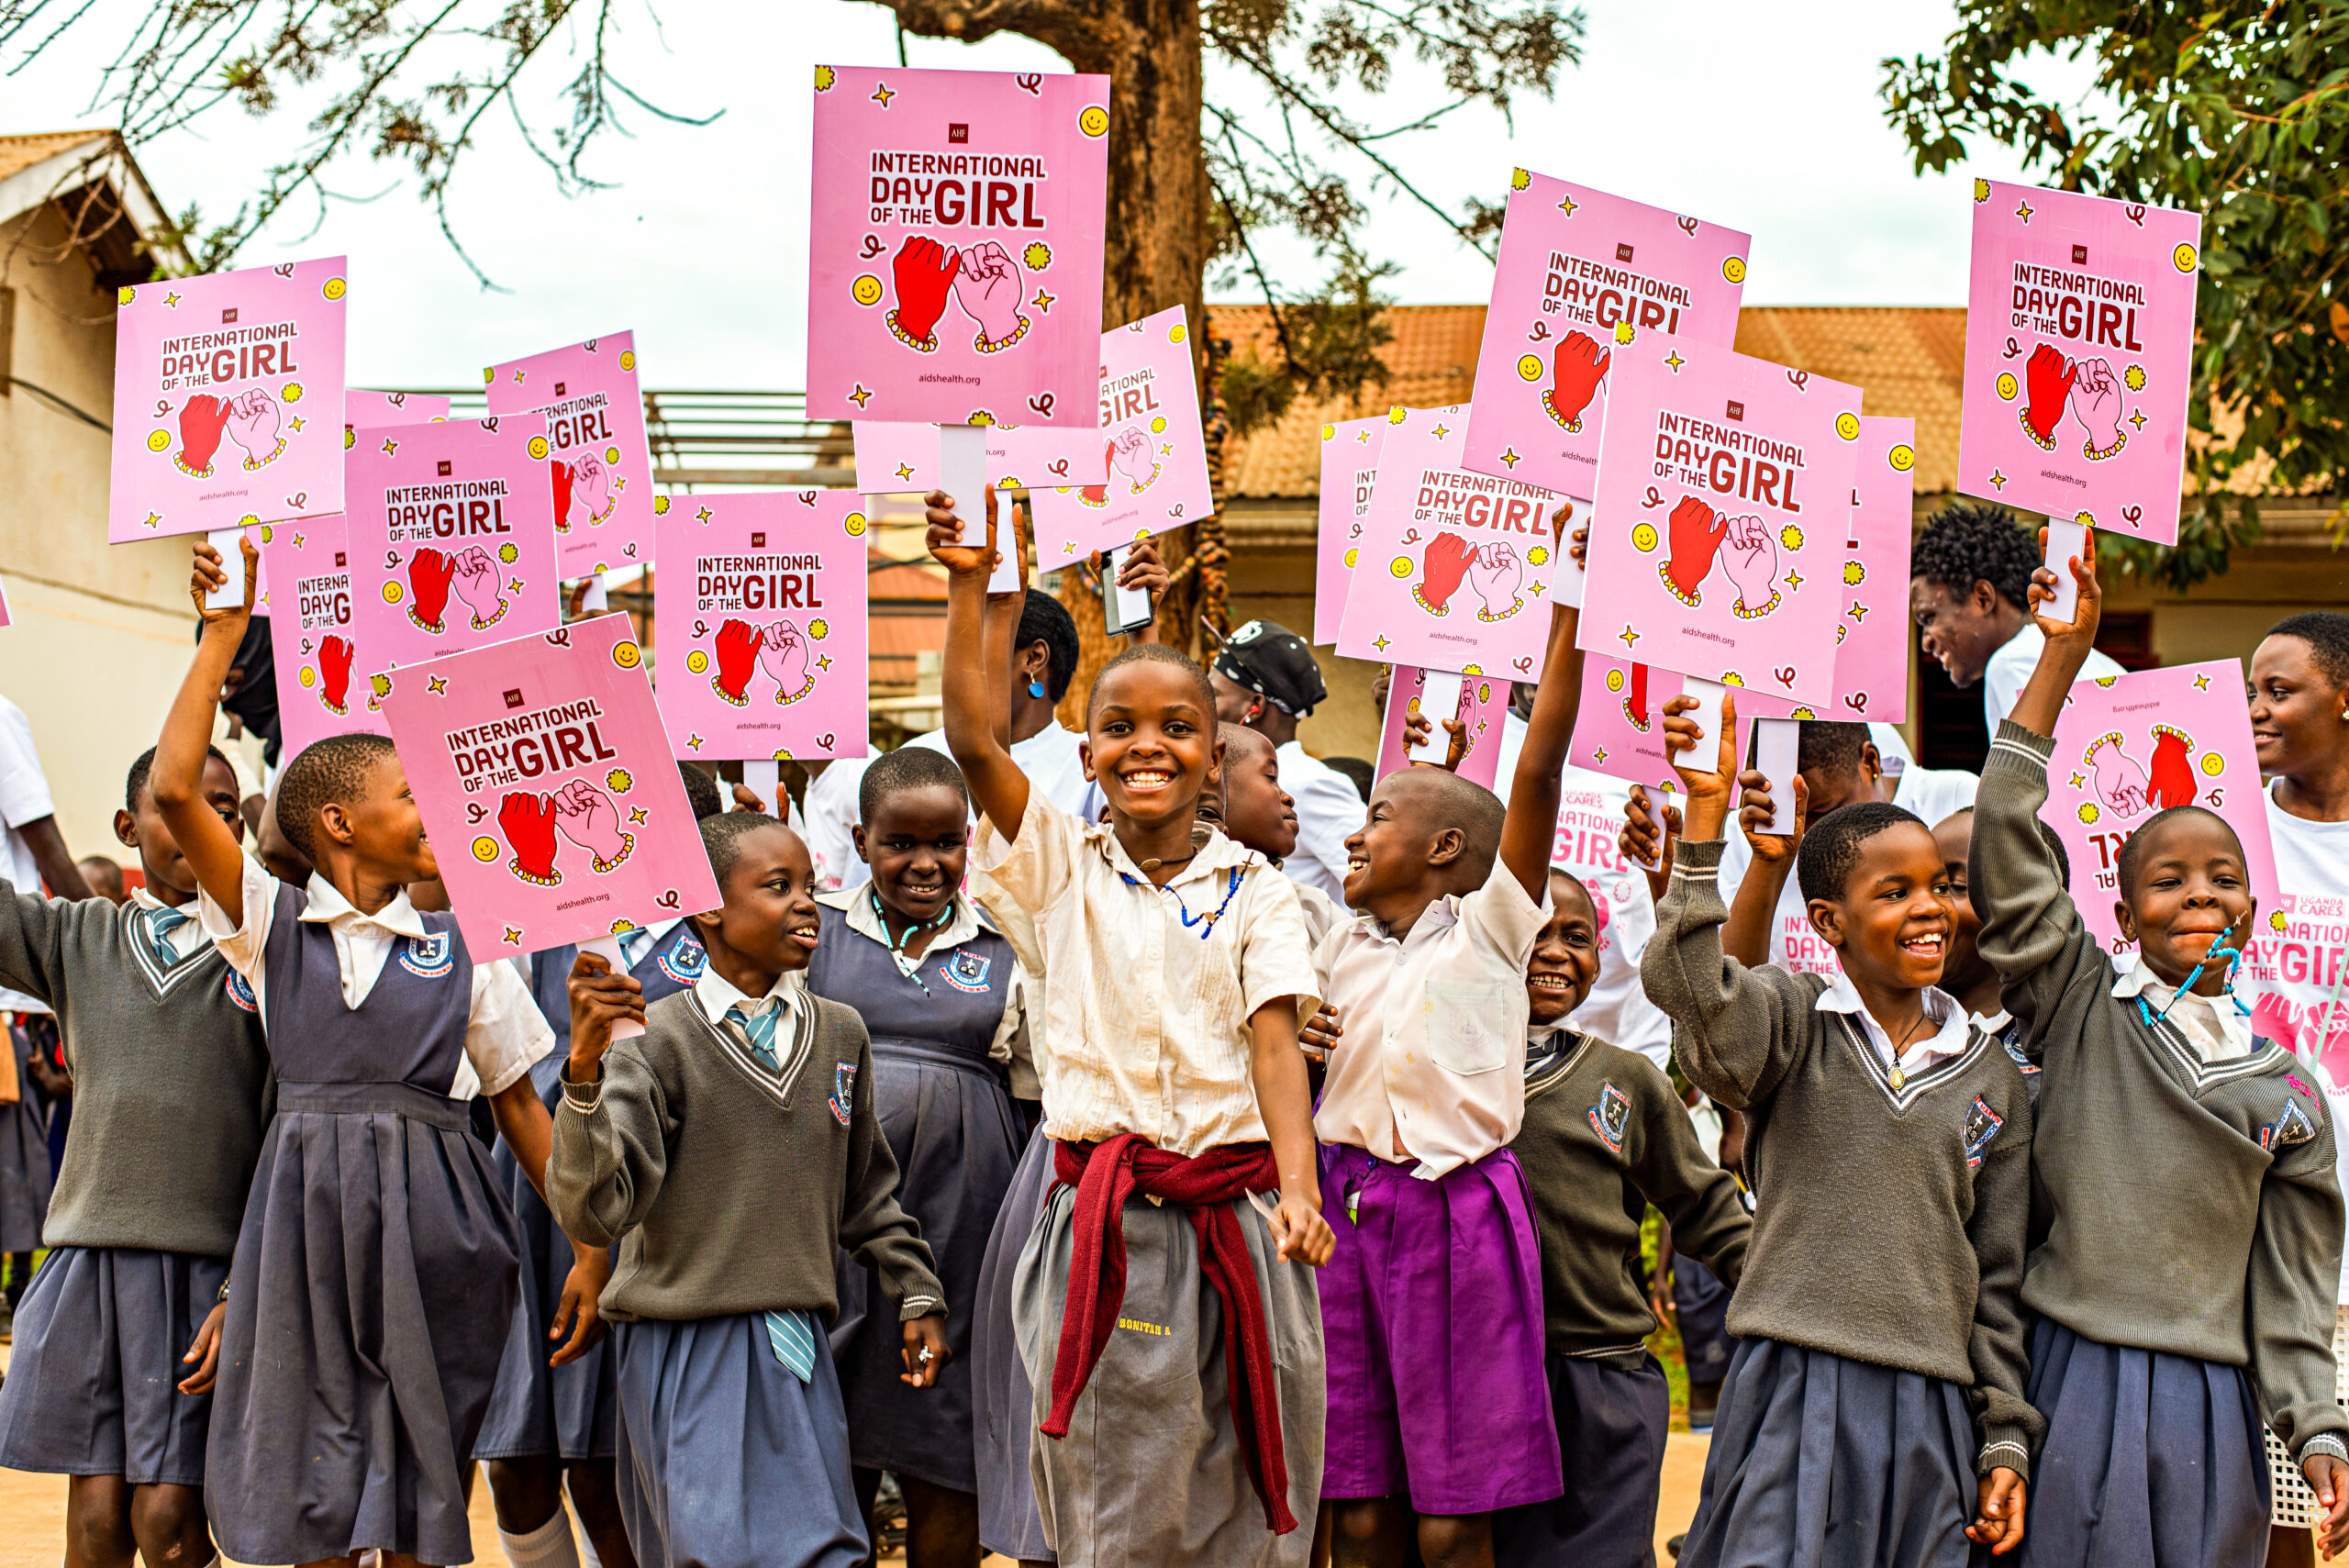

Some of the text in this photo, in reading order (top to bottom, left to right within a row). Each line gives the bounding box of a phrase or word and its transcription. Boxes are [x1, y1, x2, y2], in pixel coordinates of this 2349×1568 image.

[952, 129, 966, 138] AHF
[872, 152, 1046, 178] INTERNATIONAL
[871, 176, 933, 205] DAY
[871, 207, 932, 224] OF THE
[934, 180, 1044, 228] GIRL
[1619, 250, 1631, 258] AHF
[1545, 272, 1598, 306] DAY
[1550, 252, 1690, 307] INTERNATIONAL
[2014, 262, 2145, 306] INTERNATIONAL
[1542, 298, 1594, 324] OF THE
[2012, 284, 2058, 317] DAY
[2012, 312, 2057, 335] OF THE
[2059, 295, 2142, 352] GIRL
[163, 322, 298, 354] INTERNATIONAL
[162, 351, 210, 377] DAY
[211, 340, 297, 383] GIRL
[161, 373, 209, 391] OF THE
[918, 373, 981, 386] aidshealth.org
[1099, 368, 1155, 397] ATIONAL
[1100, 384, 1159, 428] GIRL
[1730, 406, 1742, 416] AHF
[554, 410, 613, 449] GIRL
[1659, 412, 1805, 468] INTERNATIONAL
[1656, 434, 1709, 469] DAY
[1654, 462, 1707, 488] OF THE
[1709, 450, 1800, 513] GIRL
[2041, 470, 2087, 488] aidshealth.org
[199, 489, 249, 502] aidshealth.org
[386, 480, 508, 504] INTERNATIONAL
[1417, 487, 1467, 511] DAY
[388, 504, 430, 528] DAY
[432, 499, 511, 538] GIRL
[1415, 509, 1463, 525] OF THE
[1464, 495, 1548, 536] GIRL
[389, 528, 432, 541] OF THE
[698, 555, 822, 573] INTERNATIONAL
[298, 573, 351, 595] INTERNA
[698, 575, 741, 596] DAY
[743, 573, 822, 609] GIRL
[301, 594, 332, 616] DAY
[698, 598, 742, 610] OF THE
[303, 615, 335, 629] OF THE
[1429, 631, 1478, 646] aidshealth.org
[1682, 627, 1735, 647] aidshealth.org
[507, 694, 520, 703] AHF
[447, 699, 602, 751] INTERNATIONAL
[454, 742, 509, 777] DAY
[512, 721, 616, 778] GIRL
[463, 768, 518, 793] OF THE
[1566, 796, 1603, 808] CARES
[556, 893, 610, 911] aidshealth.org
[2299, 904, 2343, 917] CARES
[2300, 896, 2343, 906] UGANDA
[1807, 962, 1833, 974] THE
[2249, 966, 2277, 981] THE
[1119, 1318, 1162, 1336] BONITAH
